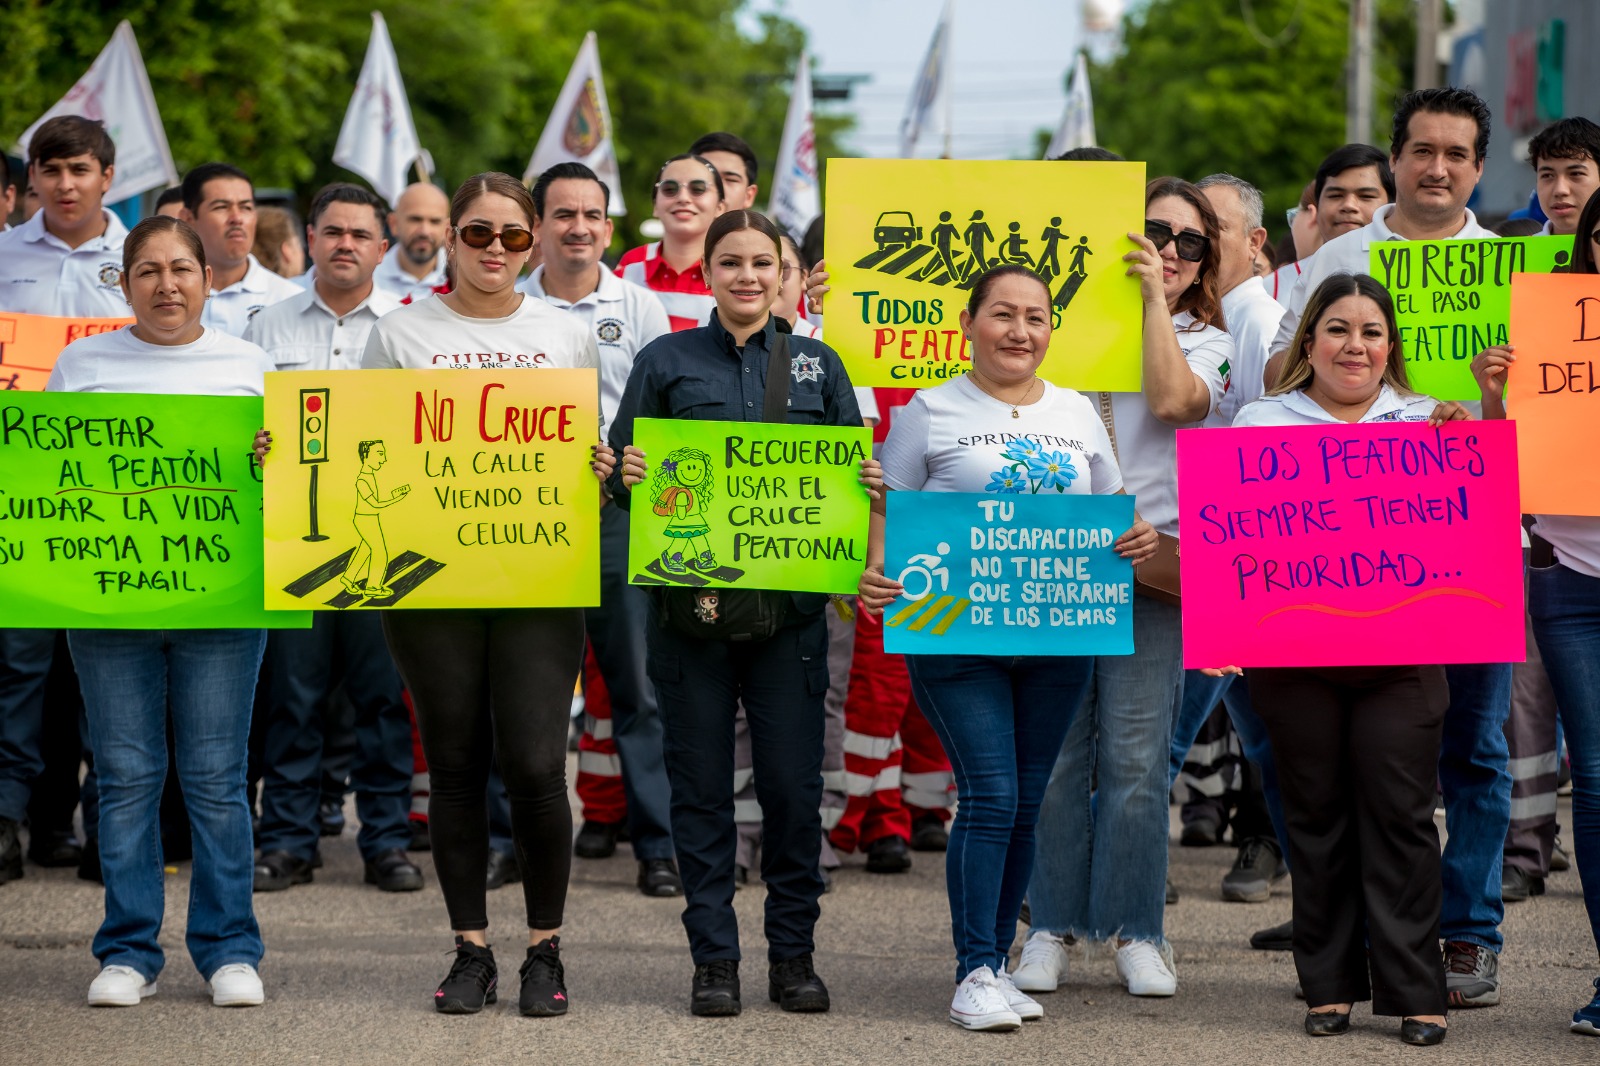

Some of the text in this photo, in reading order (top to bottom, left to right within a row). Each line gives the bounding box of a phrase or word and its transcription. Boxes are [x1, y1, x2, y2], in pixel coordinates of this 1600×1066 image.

[1379, 248, 1410, 290] YO
[853, 291, 943, 325] TODOS
[1396, 291, 1480, 314] EL PASO
[414, 383, 577, 444] NO CRUCE
[2, 406, 163, 450] RESPETAR
[725, 436, 867, 468] RECUERDA
[957, 433, 1086, 452] SPRINGTIME
[59, 459, 93, 487] AL
[108, 447, 222, 489] PEATÓN
[425, 451, 545, 477] LA CALLE
[1238, 427, 1484, 484] LOS PEATONES
[434, 486, 564, 509] VIENDO EL
[727, 475, 827, 500] USAR EL
[121, 494, 158, 524] LA
[173, 491, 240, 525] VIDA
[728, 506, 821, 526] CRUCE
[978, 500, 1014, 522] TU
[1200, 486, 1468, 544] SIEMPRE TIENEN
[458, 522, 570, 546] CELULAR
[971, 527, 1113, 551] DISCAPACIDAD
[44, 535, 142, 564] FORMA
[161, 534, 230, 562] MAS
[734, 533, 862, 562] PEATONAL
[971, 556, 1090, 580] NO TIENE
[94, 570, 206, 594] FRAGIL.
[967, 581, 1129, 604] QUE SEPARARME
[972, 606, 1116, 627] DE LOS DEMAS
